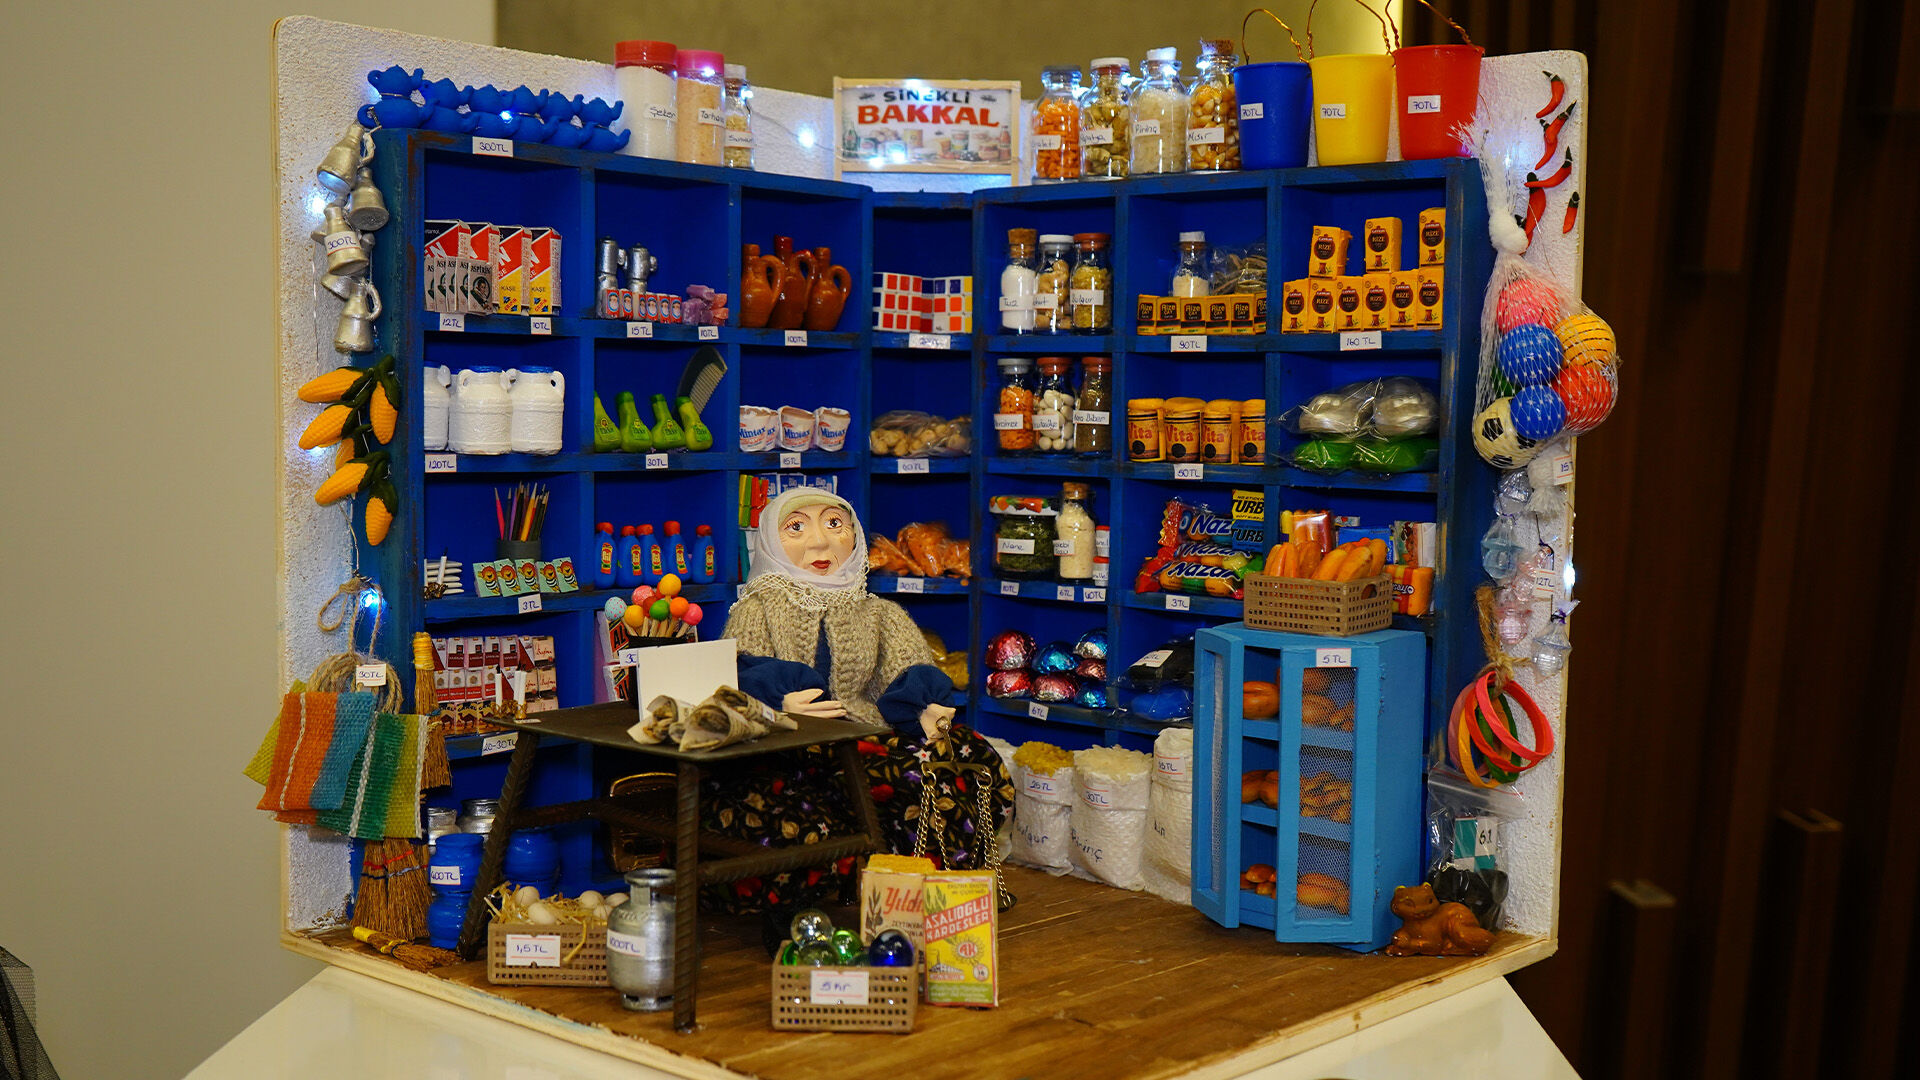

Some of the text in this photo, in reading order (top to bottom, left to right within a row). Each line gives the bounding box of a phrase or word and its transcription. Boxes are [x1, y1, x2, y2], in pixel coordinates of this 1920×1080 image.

[857, 104, 1000, 128] BAKKAL
[479, 141, 509, 153] 300TL
[442, 318, 462, 329] 12TL
[1346, 337, 1376, 347] 160 TL
[1165, 425, 1195, 443] Vita
[1240, 423, 1265, 441] Vita
[428, 459, 455, 470] 120TL
[647, 458, 667, 467] 30TL
[1232, 499, 1265, 515] TURB
[1190, 512, 1233, 536] Naz
[1231, 527, 1264, 543] TURB
[1168, 561, 1242, 581] Nazar
[1031, 707, 1045, 718] 6TL
[534, 944, 548, 954] TL
